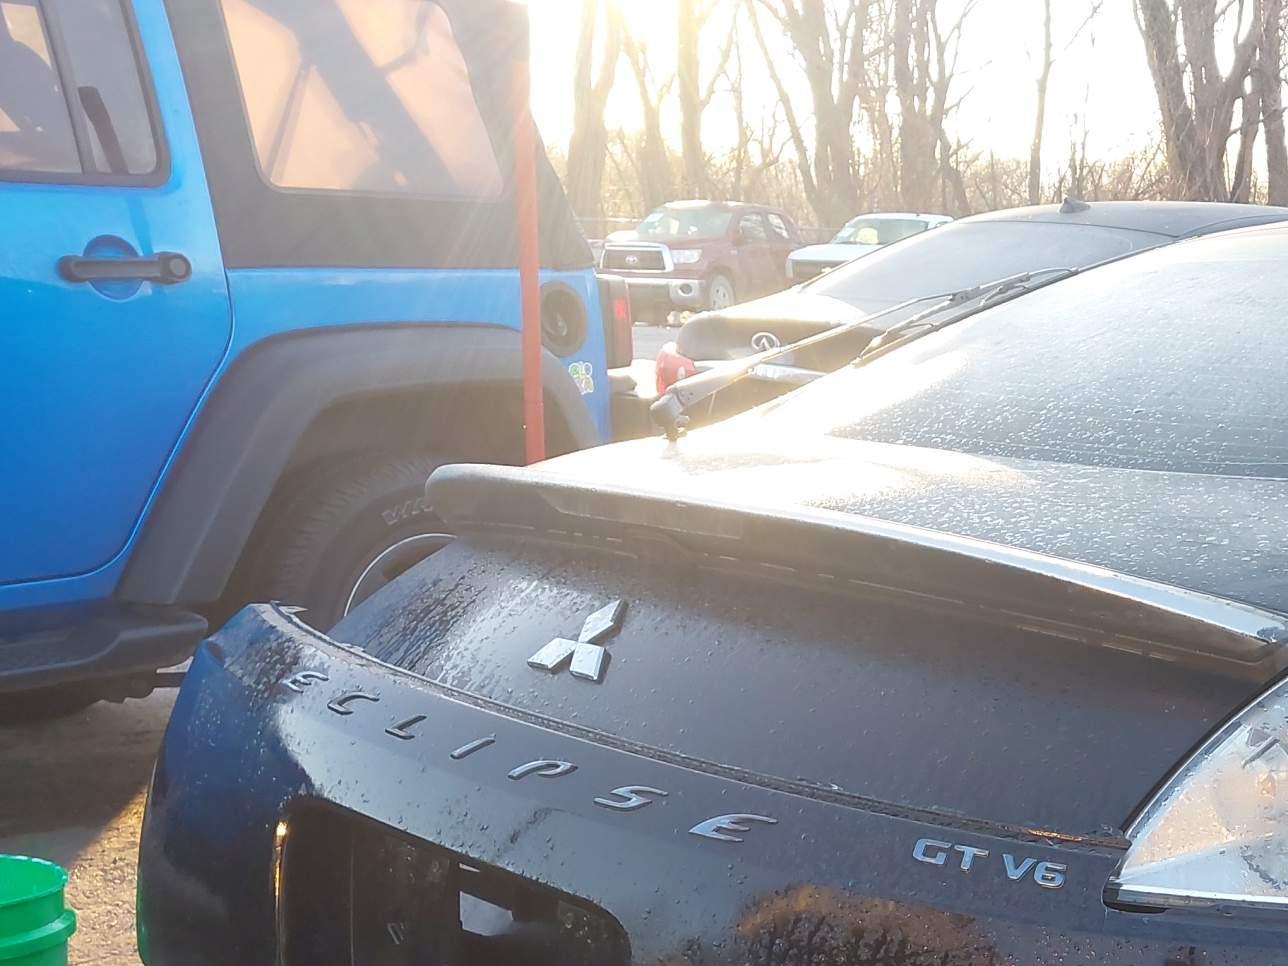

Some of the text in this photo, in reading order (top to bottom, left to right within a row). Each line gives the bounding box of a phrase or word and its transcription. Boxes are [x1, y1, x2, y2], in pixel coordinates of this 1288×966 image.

[280, 669, 779, 843] ECLIPSE
[912, 838, 1067, 888] GT V6
